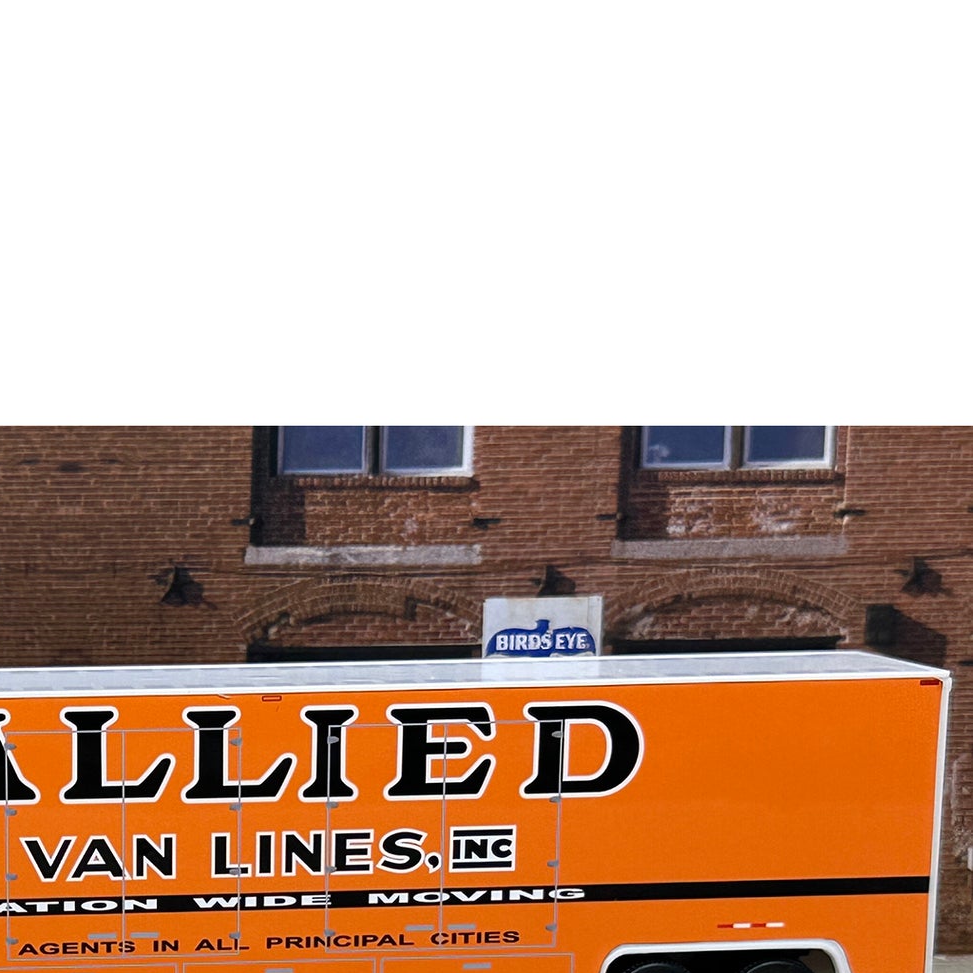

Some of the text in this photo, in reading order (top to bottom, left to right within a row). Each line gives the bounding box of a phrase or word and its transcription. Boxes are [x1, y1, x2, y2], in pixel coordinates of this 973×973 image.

[495, 633, 588, 650] BIRDS EYE
[19, 829, 513, 882] VAN LINES, INC
[193, 895, 333, 909] WIDE
[368, 888, 585, 904] MOVING
[18, 931, 520, 956] AGENTS IN ALL PRINCIPAL CITIES
